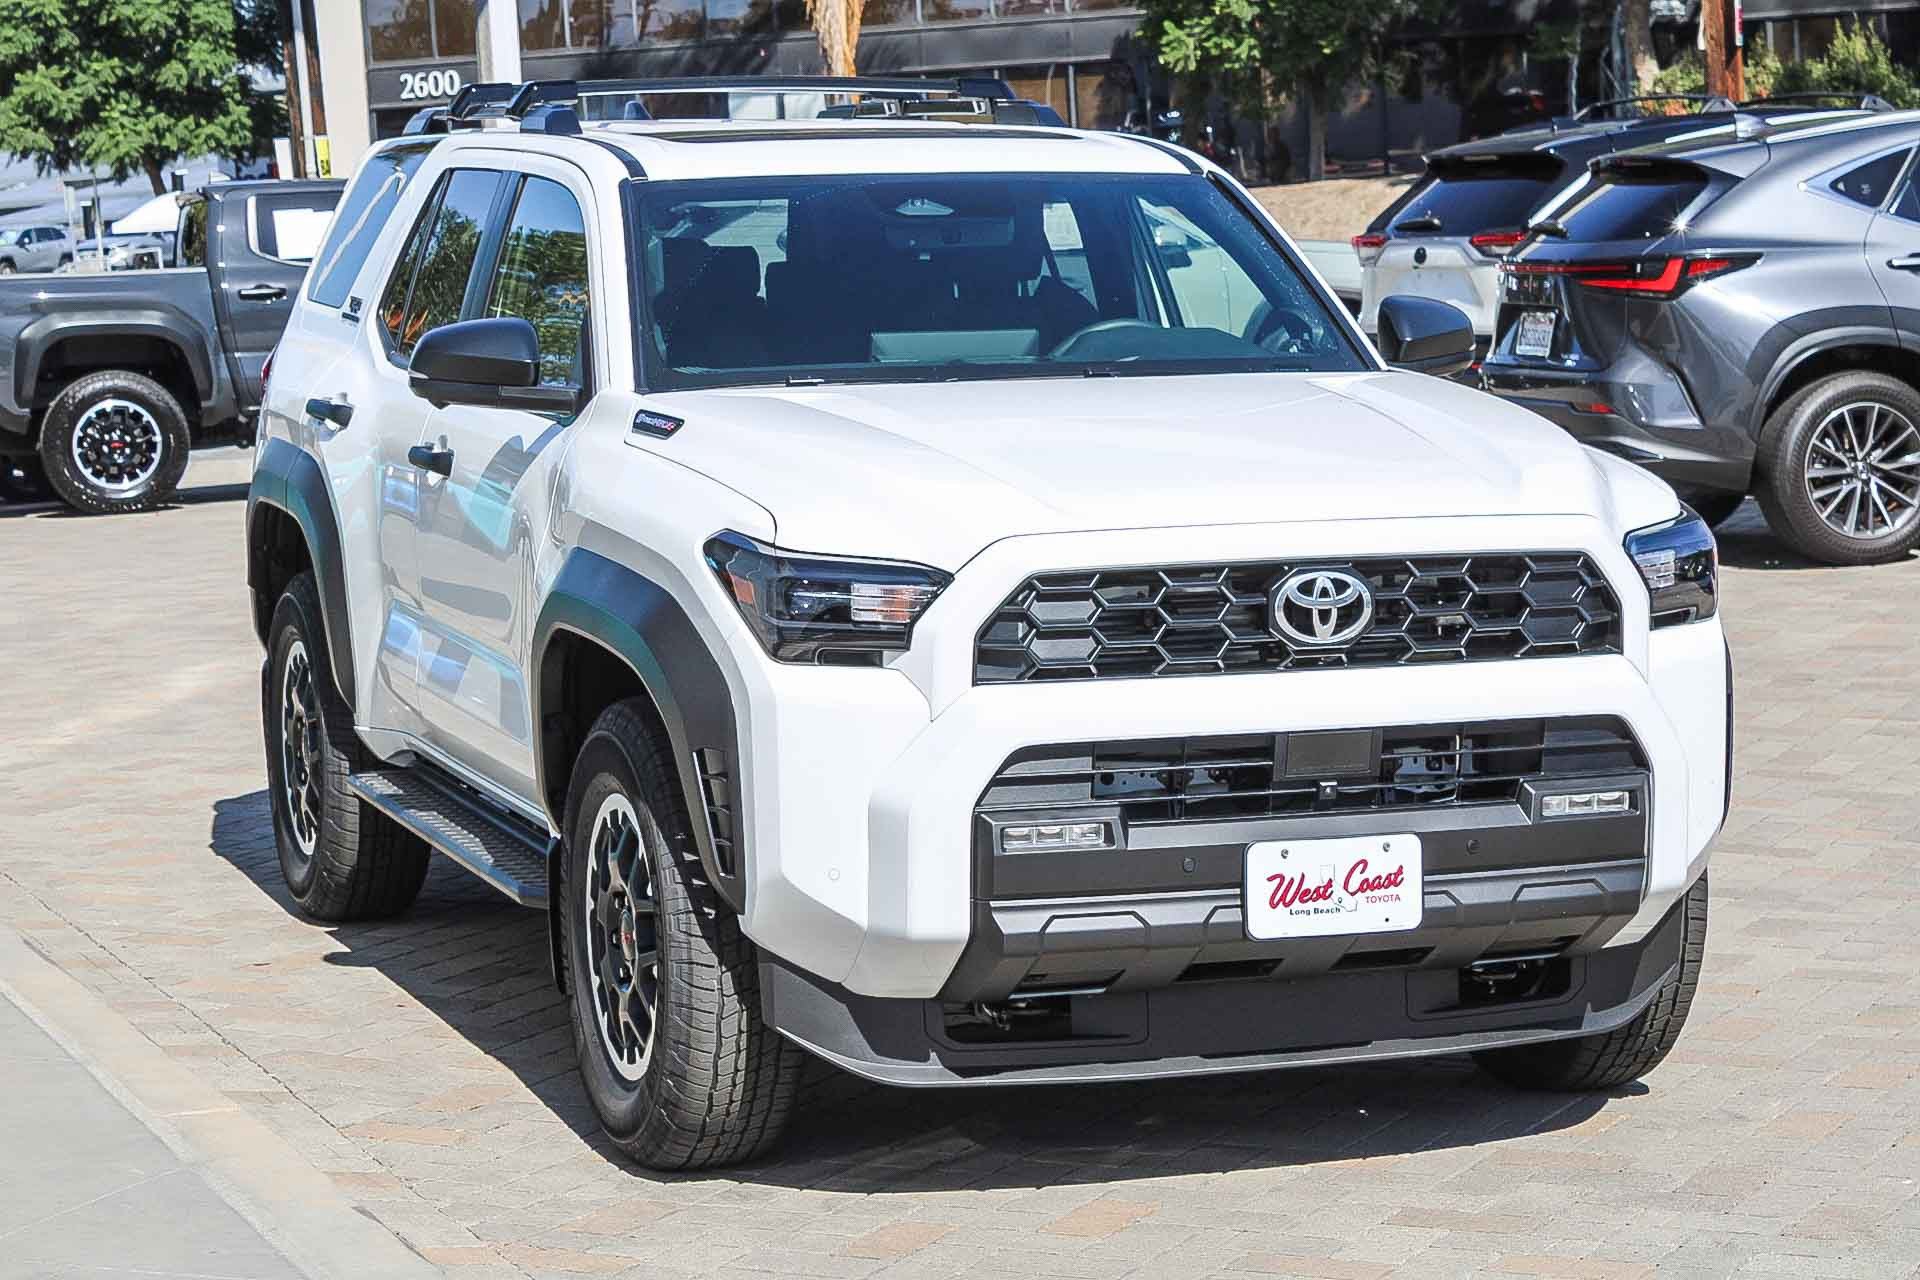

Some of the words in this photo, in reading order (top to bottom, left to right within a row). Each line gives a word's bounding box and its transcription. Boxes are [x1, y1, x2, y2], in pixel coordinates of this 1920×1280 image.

[400, 69, 461, 99] 2600
[1266, 872, 1334, 909] West
[1343, 858, 1404, 896] Coast
[1365, 895, 1401, 904] TOYOTA
[1289, 907, 1312, 916] Long
[1313, 906, 1341, 915] Beach
